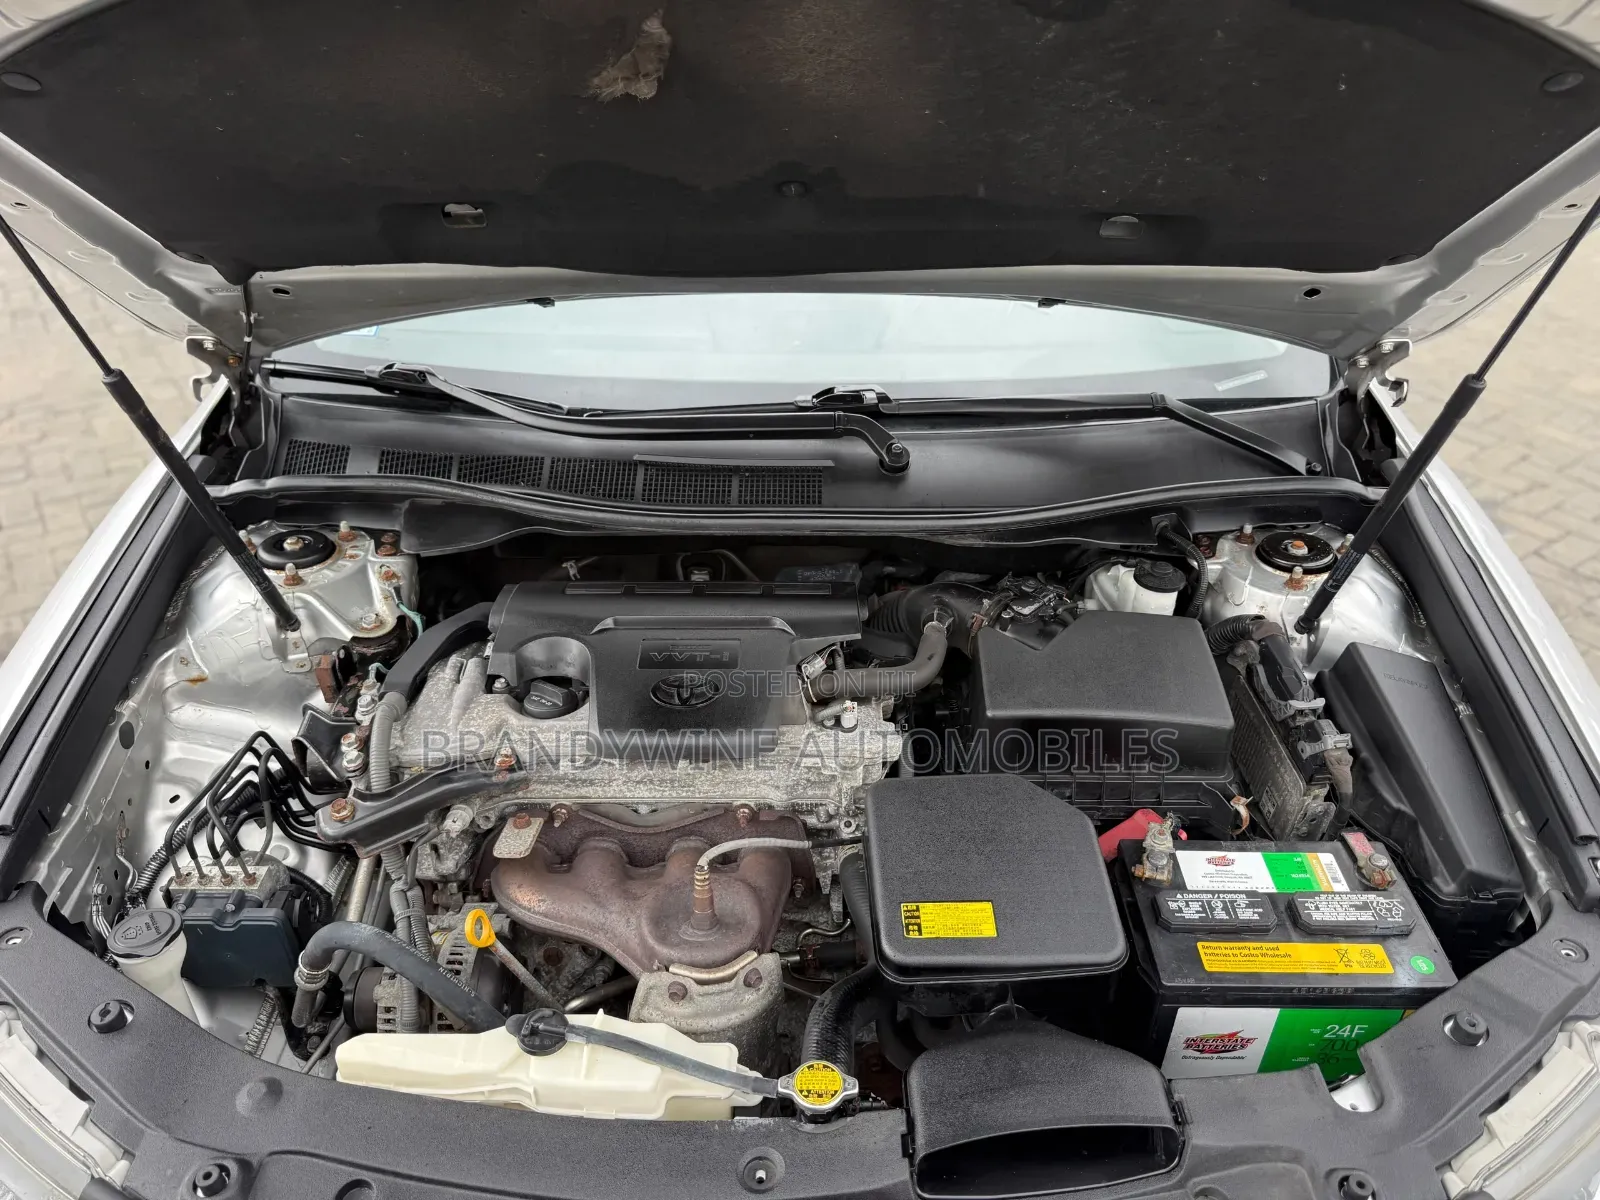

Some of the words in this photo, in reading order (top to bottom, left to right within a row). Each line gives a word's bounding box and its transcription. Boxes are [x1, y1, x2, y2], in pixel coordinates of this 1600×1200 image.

[1323, 1024, 1369, 1038] 24F
[1184, 1043, 1250, 1051] BATTERIES
[1319, 1039, 1360, 1052] 700
